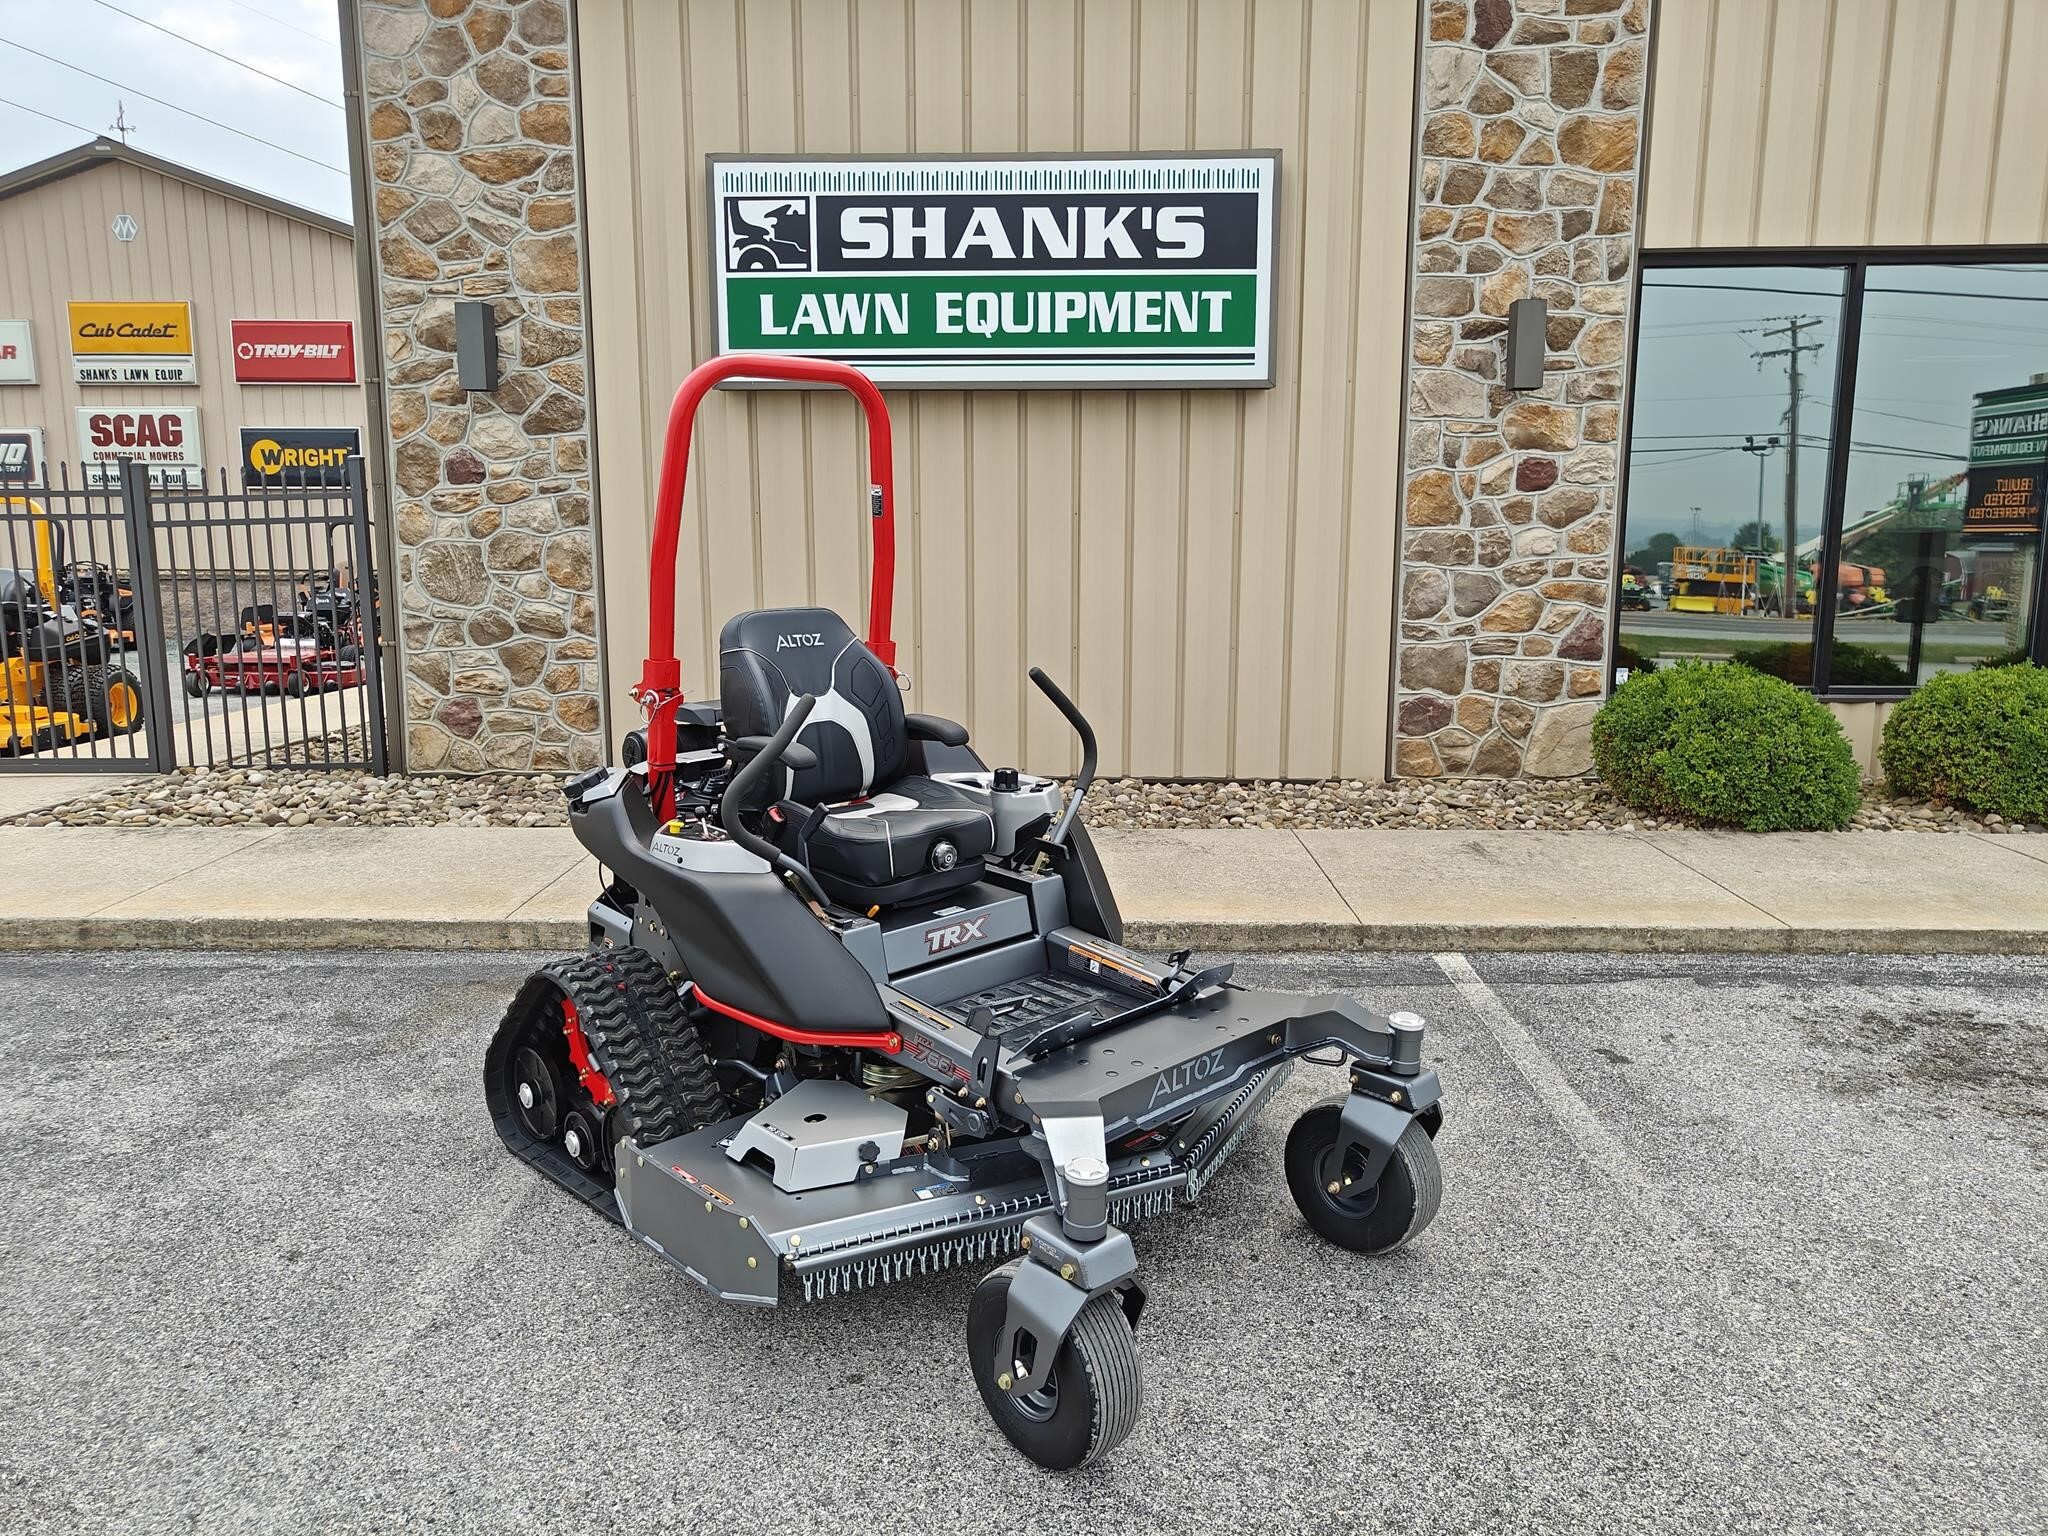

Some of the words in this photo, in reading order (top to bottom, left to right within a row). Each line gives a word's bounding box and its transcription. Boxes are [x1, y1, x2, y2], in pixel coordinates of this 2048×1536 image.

[839, 205, 1206, 260] SHANK'S
[759, 292, 909, 336] LAWN
[935, 290, 1233, 338] EQUIPMENT
[79, 322, 115, 338] Cub
[116, 322, 177, 338] Cadet
[254, 344, 342, 359] TROY-BILT
[80, 368, 117, 381] SHANK'S
[123, 369, 149, 381] LAWN
[89, 414, 184, 448] SCAG
[149, 451, 184, 461] MOWERS
[259, 447, 348, 467] WRIGHT
[776, 633, 825, 652] ALTOZ
[651, 841, 681, 857] ALTOZ
[925, 914, 990, 955] TRX
[917, 1034, 934, 1048] TRX
[1147, 1047, 1225, 1110] ALTOZ
